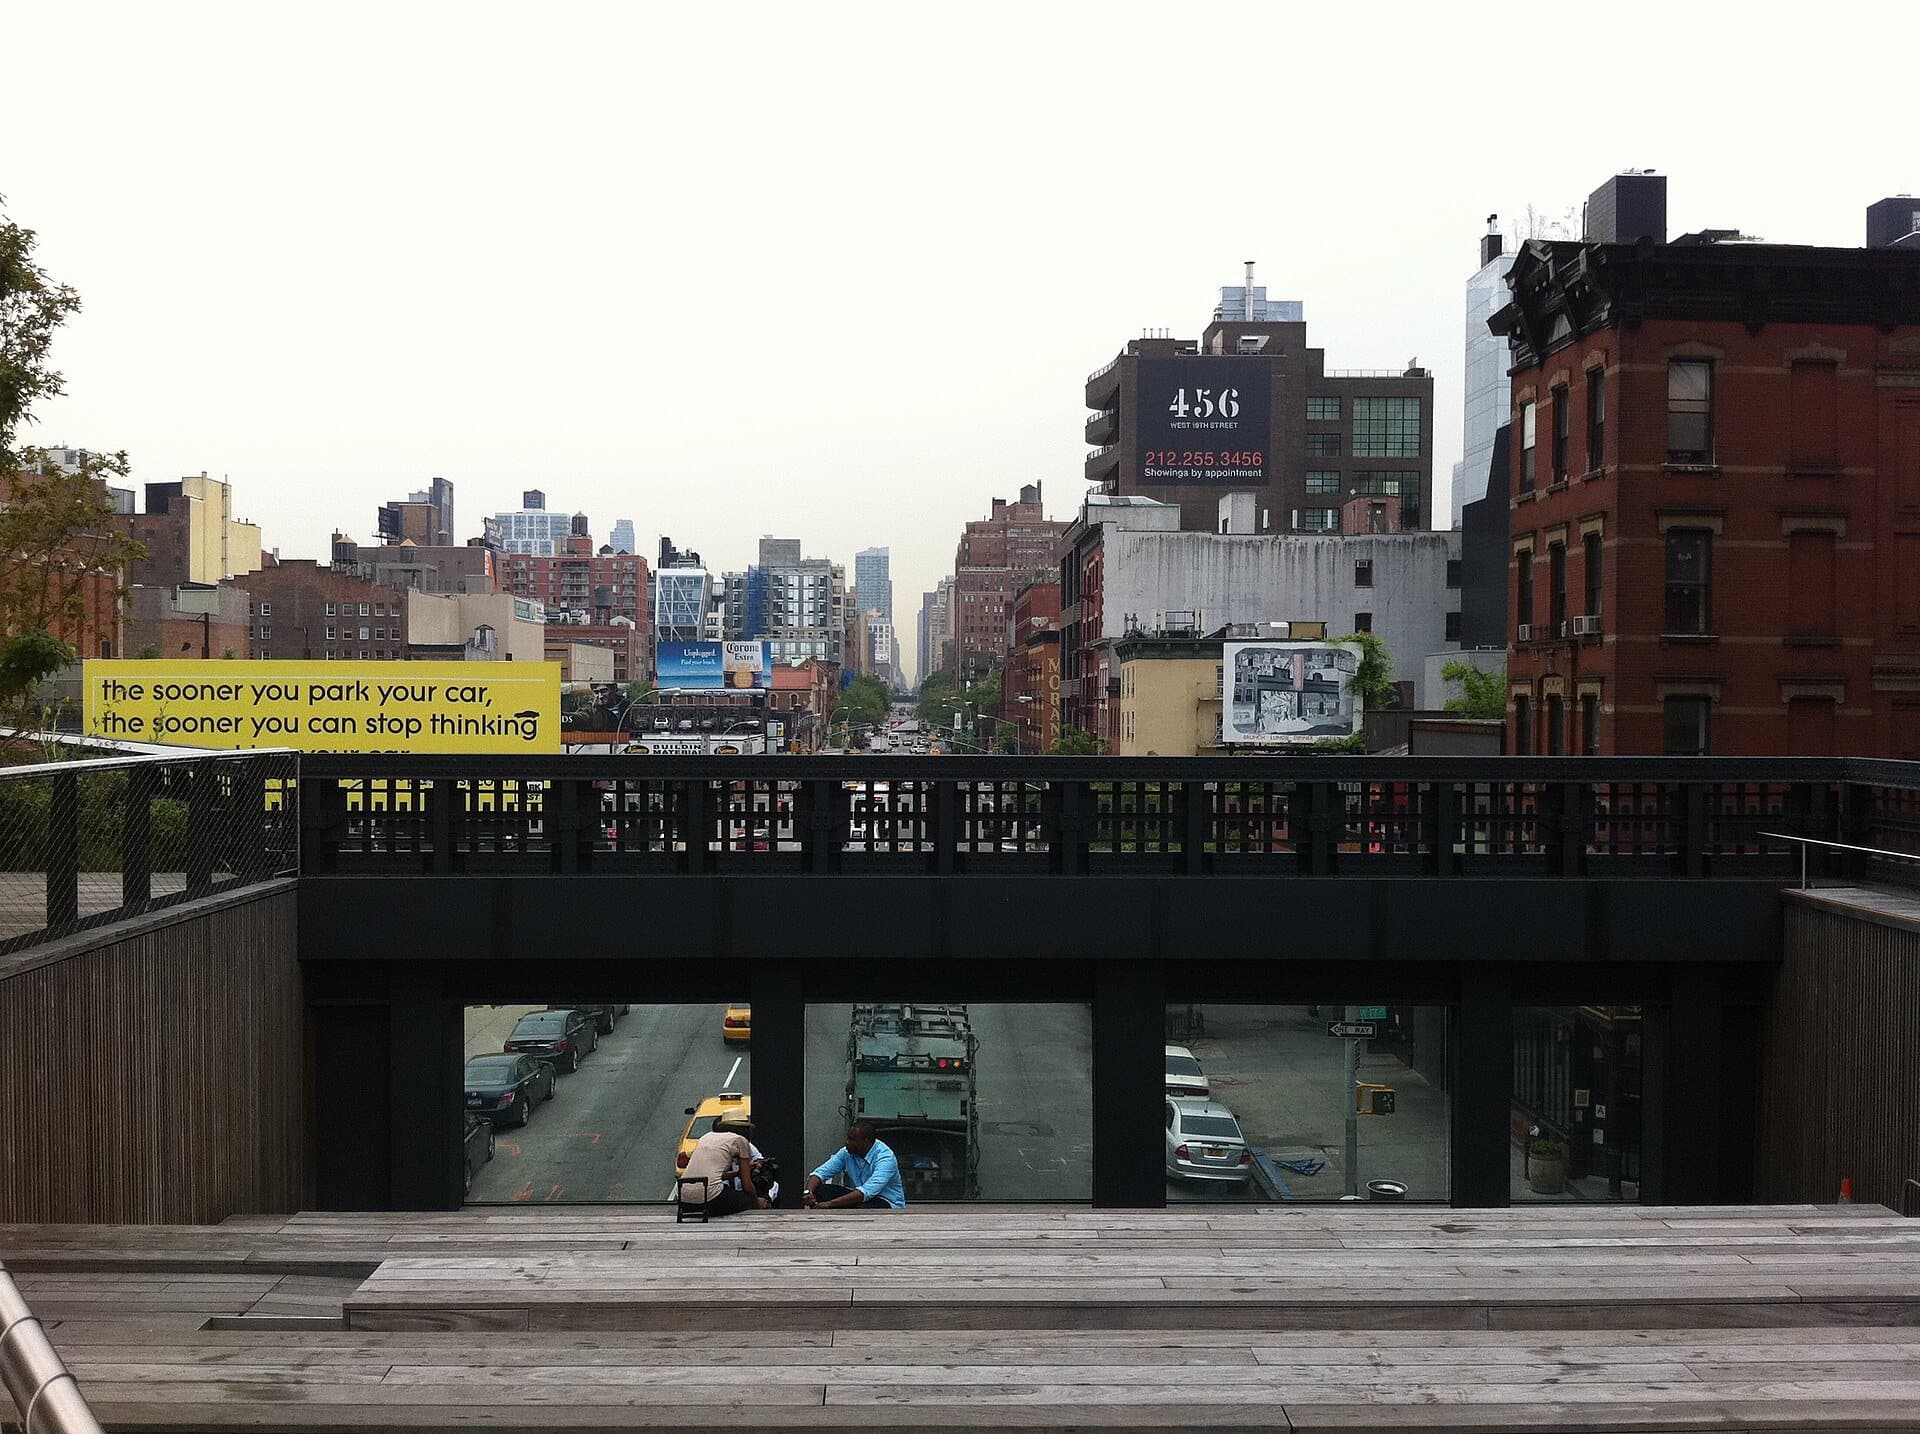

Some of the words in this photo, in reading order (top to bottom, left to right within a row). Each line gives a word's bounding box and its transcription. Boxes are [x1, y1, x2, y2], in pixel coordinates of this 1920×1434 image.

[1169, 387, 1241, 419] 456
[1170, 422, 1190, 430] WEST
[1210, 422, 1239, 430] STREET
[1145, 451, 1263, 467] 212.255.3456
[1144, 467, 1188, 479] Showings
[1191, 467, 1202, 479] by
[1205, 468, 1263, 479] appointment
[102, 679, 144, 701] the
[153, 684, 243, 701] sooner
[251, 684, 299, 706] you
[308, 680, 369, 706] park
[377, 685, 437, 707] your
[445, 686, 492, 707] car,
[102, 712, 144, 733] the
[153, 716, 243, 733] sooner
[251, 717, 299, 738] you
[308, 717, 357, 734] can
[365, 713, 422, 738] stop
[430, 712, 537, 740] thinking
[1334, 1025, 1348, 1033] ONE
[1354, 1026, 1370, 1034] WAY
